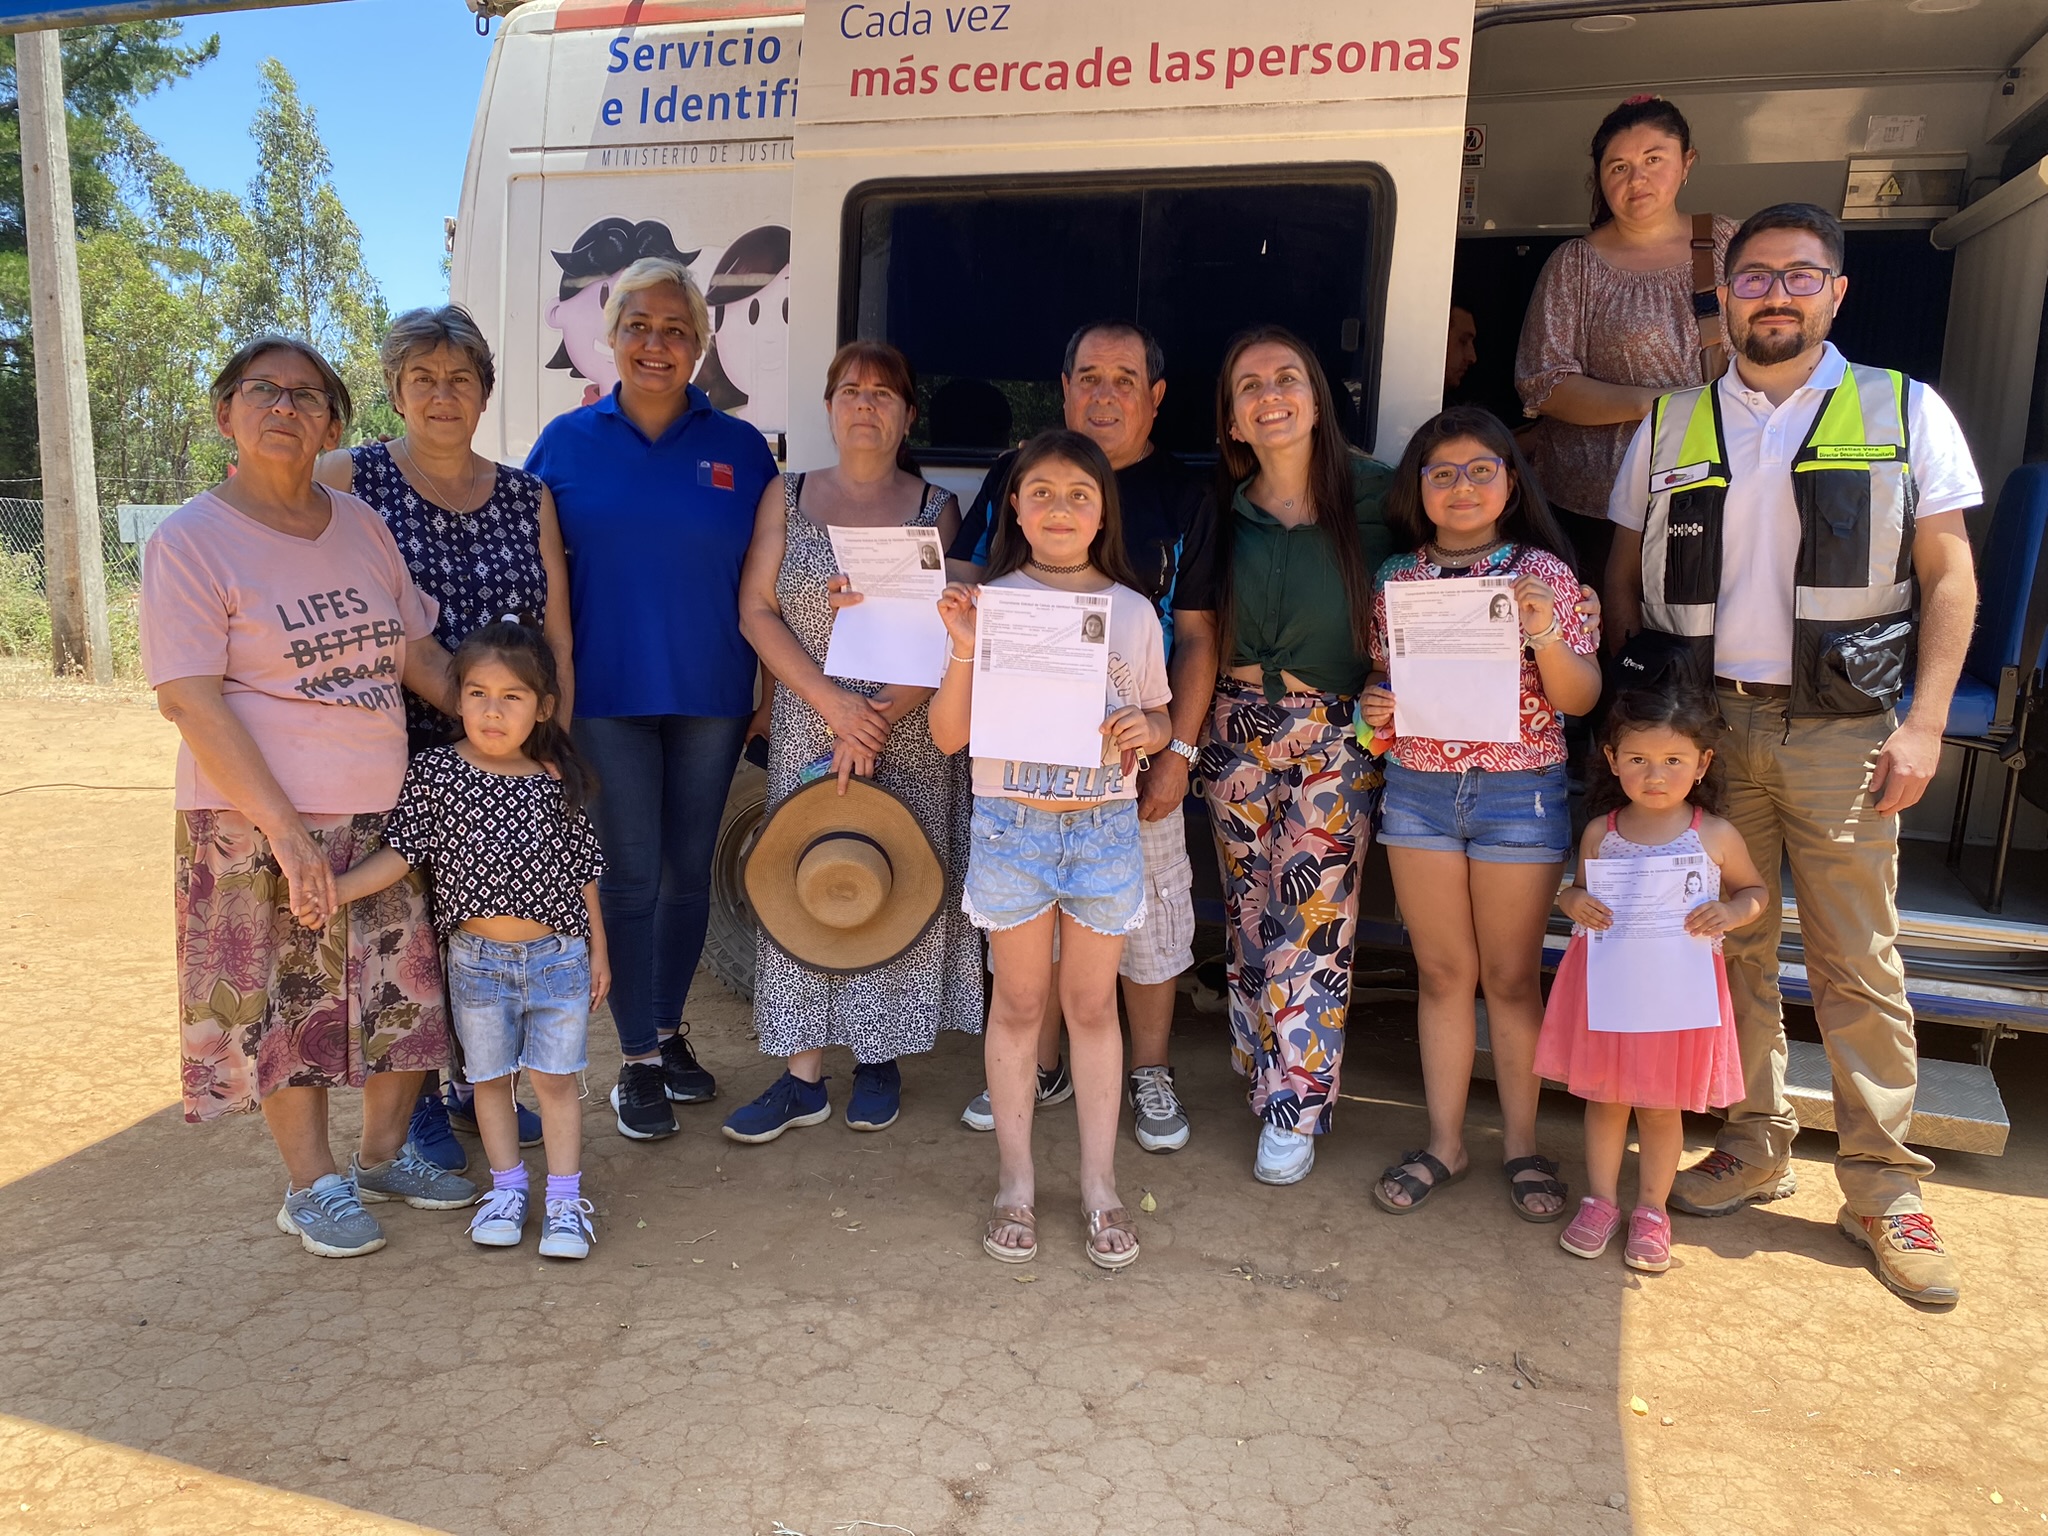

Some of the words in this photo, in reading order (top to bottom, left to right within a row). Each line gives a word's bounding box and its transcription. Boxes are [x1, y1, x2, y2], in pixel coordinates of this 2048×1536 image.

[840, 1, 932, 39] Cada
[945, 4, 1011, 33] vez
[606, 27, 781, 74] Servicio
[850, 54, 939, 97] más
[1149, 42, 1216, 84] las
[1225, 36, 1461, 90] personas
[601, 98, 623, 126] e
[601, 146, 699, 167] MINISTERIO
[709, 145, 728, 163] DE
[276, 587, 369, 631] LIFES
[287, 618, 404, 668] BETTER
